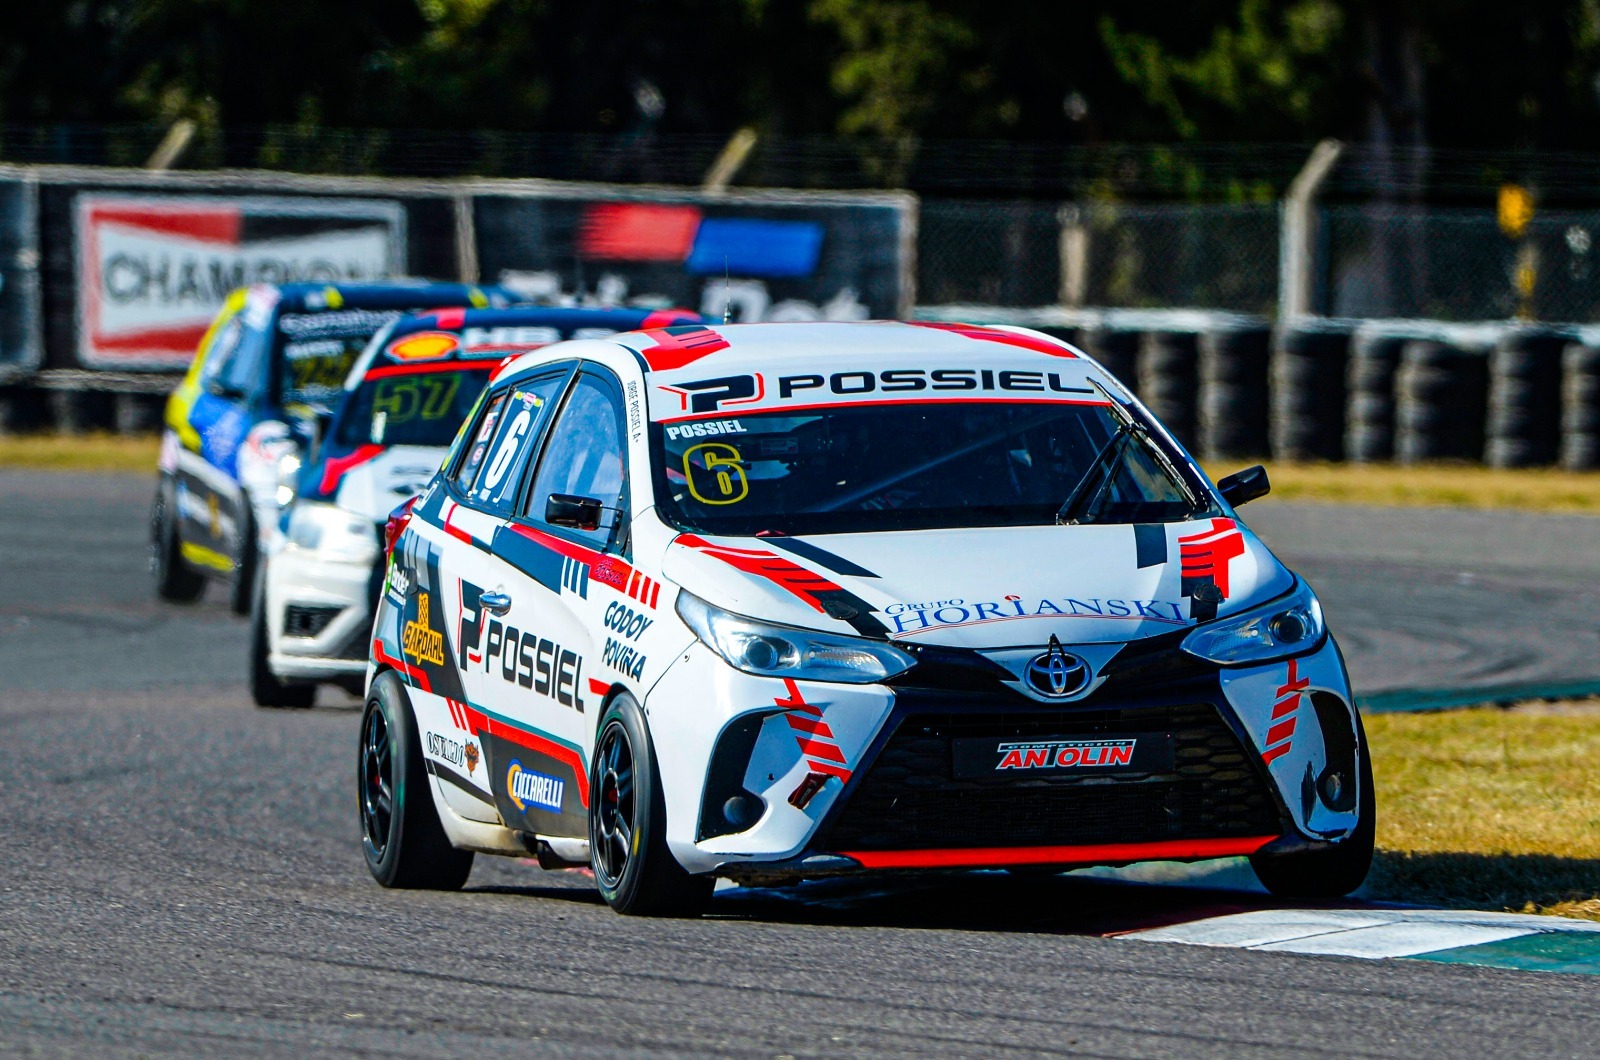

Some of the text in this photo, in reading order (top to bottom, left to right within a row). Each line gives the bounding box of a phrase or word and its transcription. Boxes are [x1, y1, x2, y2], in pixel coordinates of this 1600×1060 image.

[778, 369, 1095, 398] POSSIEL
[630, 399, 641, 433] POSSIEL
[666, 419, 747, 440] POSSIEL
[484, 410, 531, 489] 6
[683, 443, 749, 505] 6
[604, 600, 654, 642] GODOY
[884, 598, 965, 615] GRUPO
[892, 595, 1188, 634] HORIANSKI
[403, 622, 443, 664] BARDAHL
[602, 637, 647, 683] POVIÑA
[485, 618, 585, 714] POSSIEL
[426, 731, 466, 768] OSVALDO
[512, 770, 564, 809] CICCARELLI
